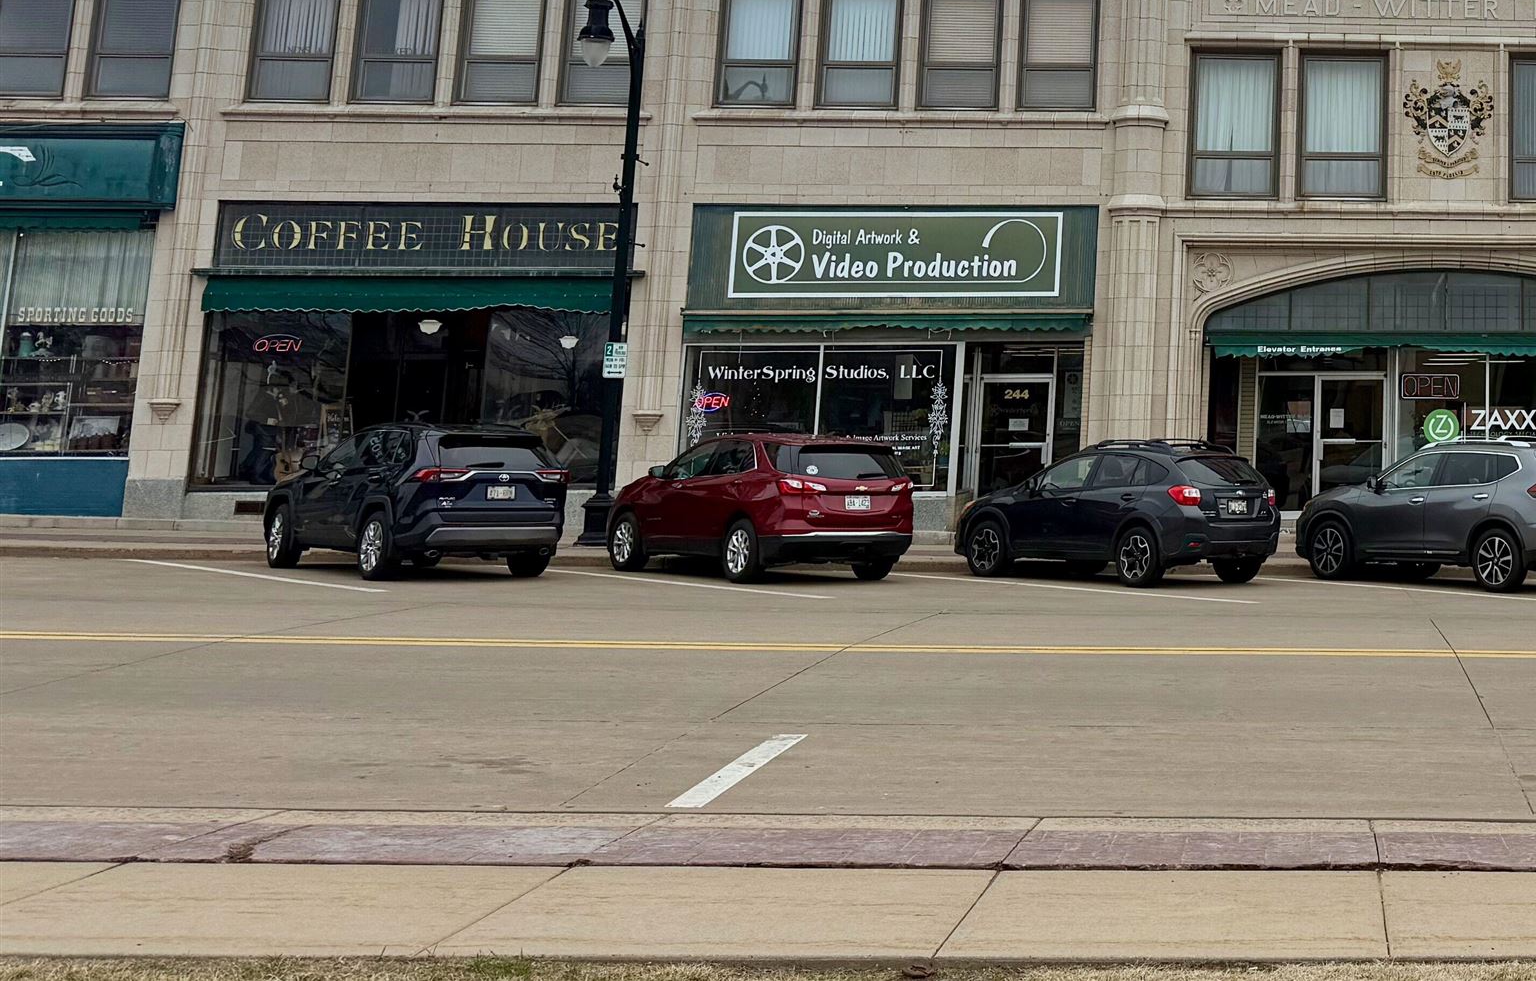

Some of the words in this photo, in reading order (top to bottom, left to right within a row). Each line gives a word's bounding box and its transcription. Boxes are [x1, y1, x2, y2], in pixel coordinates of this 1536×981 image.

[232, 213, 423, 251] COFFEE
[460, 214, 619, 252] HOUSE
[812, 228, 851, 249] Digital
[855, 229, 903, 245] Artwork
[907, 229, 921, 245] &
[811, 251, 879, 279] Video
[886, 251, 1018, 278] Production
[17, 306, 87, 323] SPORTING
[90, 307, 135, 323] GOODS
[254, 338, 303, 352] OPEN
[606, 345, 612, 355] 2
[1257, 345, 1297, 353] Elevator
[1300, 345, 1342, 353] Entrance
[708, 365, 816, 384] WinterSpring
[825, 365, 890, 379] Studios,
[900, 364, 936, 379] LLC
[1004, 388, 1030, 400] 244
[1404, 376, 1458, 397] OPEN
[695, 396, 730, 408] OPEN
[873, 433, 899, 441] Artwork
